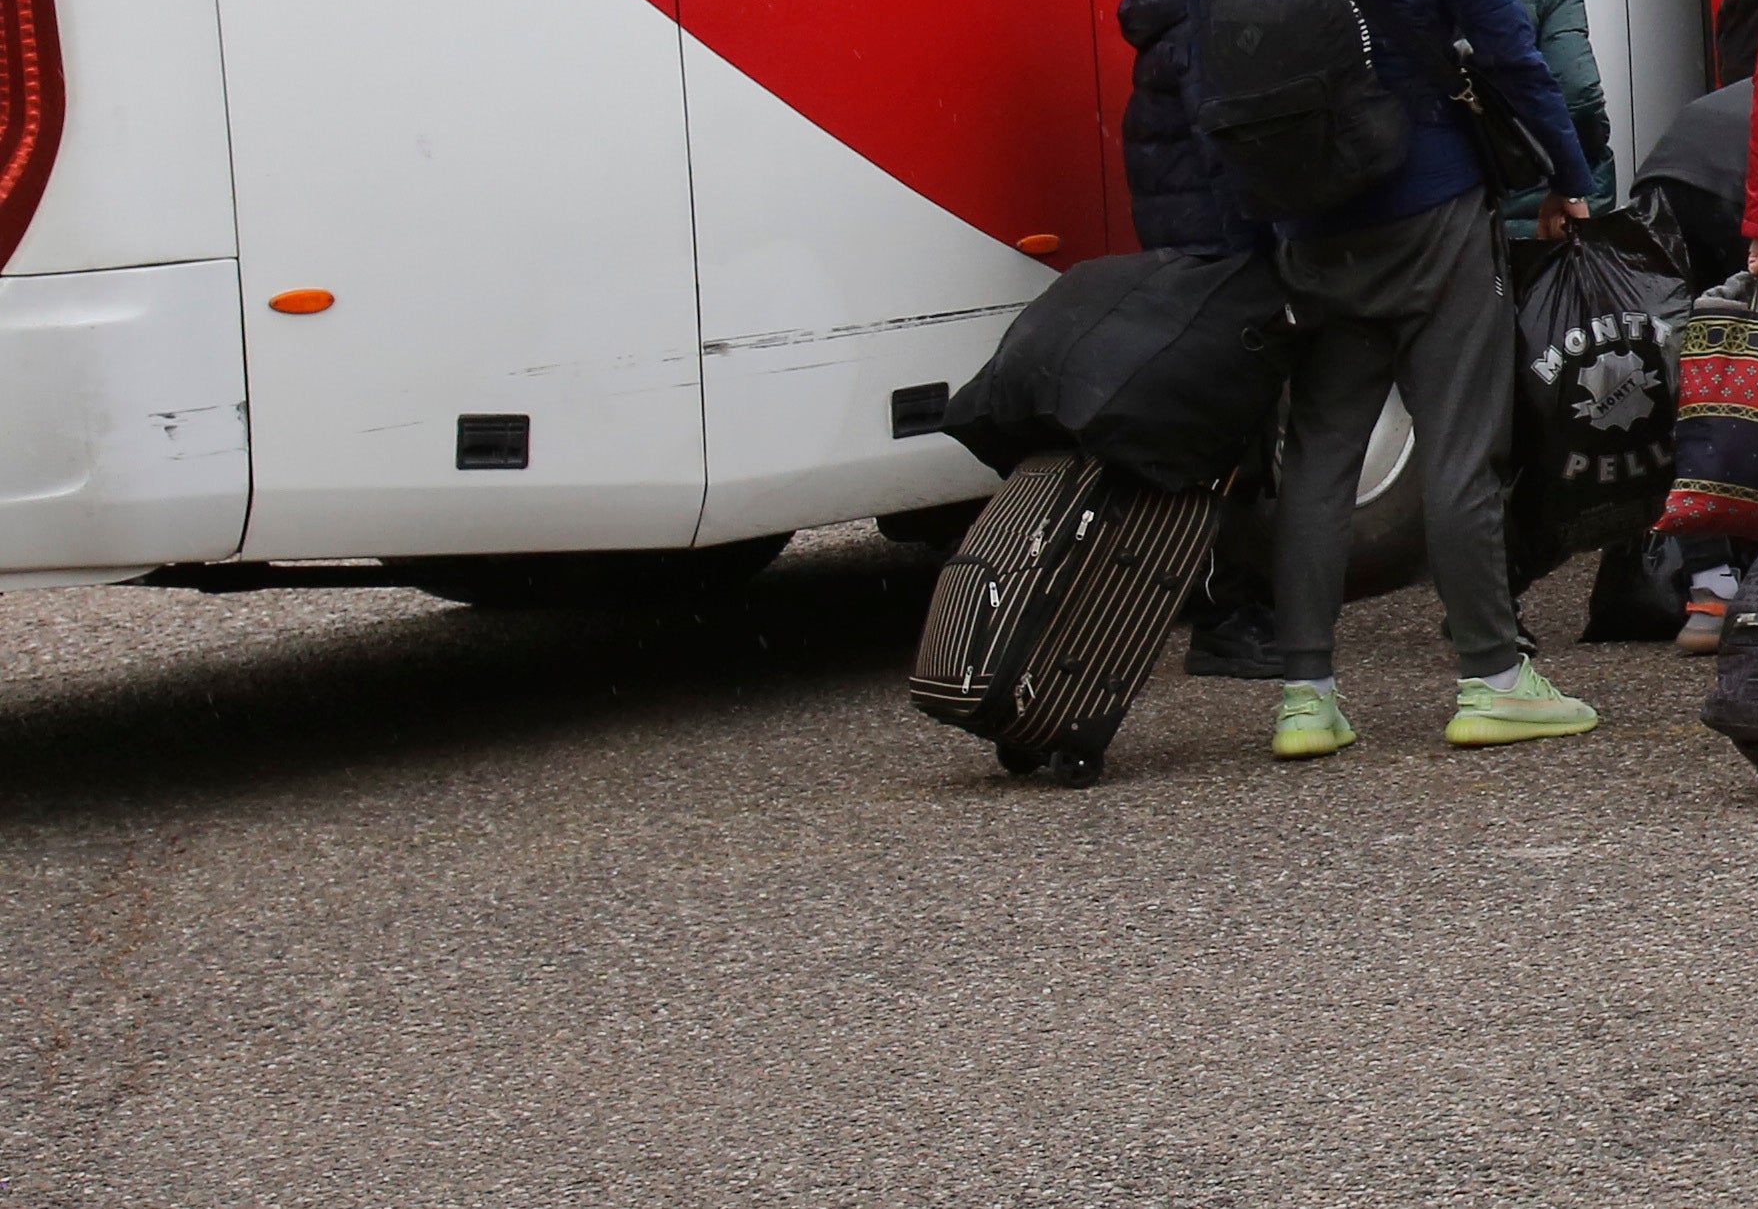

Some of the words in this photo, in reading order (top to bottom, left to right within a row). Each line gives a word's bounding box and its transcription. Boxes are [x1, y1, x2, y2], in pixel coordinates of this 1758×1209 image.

[1530, 311, 1672, 385] MONTT
[1596, 378, 1636, 415] MONTT
[1562, 443, 1674, 483] PELL
